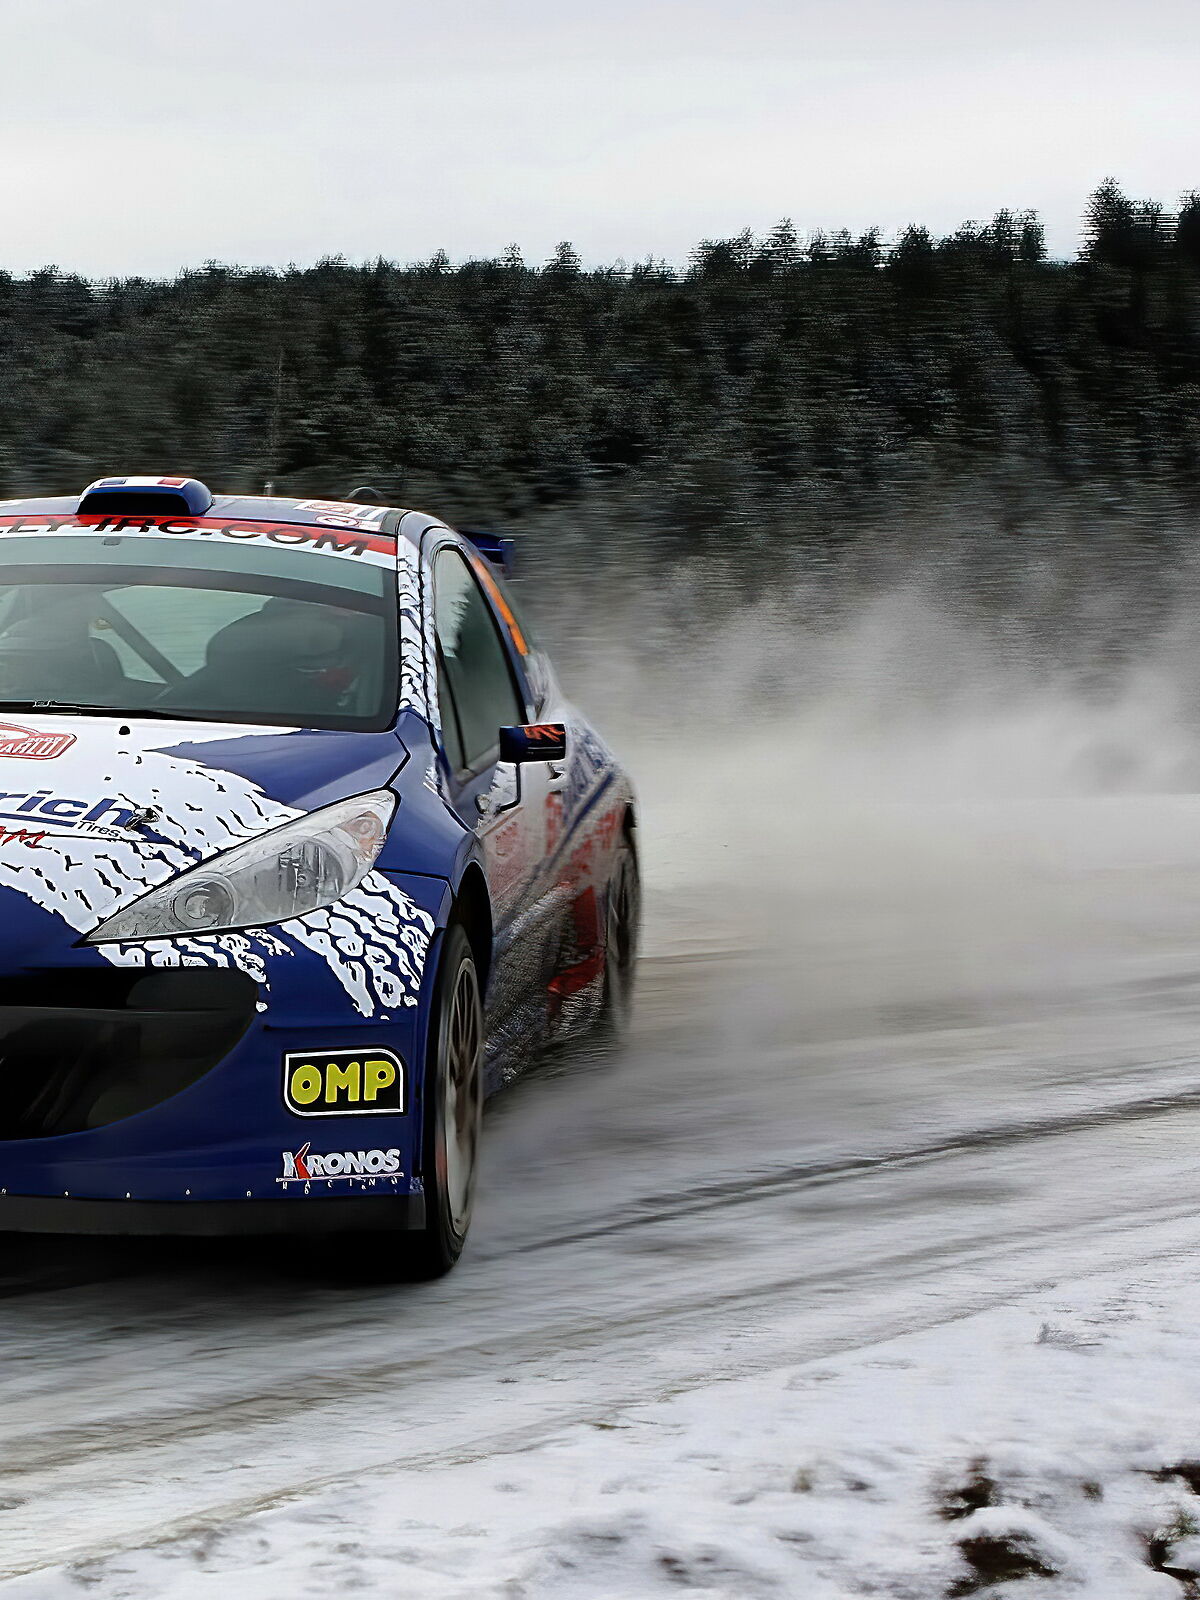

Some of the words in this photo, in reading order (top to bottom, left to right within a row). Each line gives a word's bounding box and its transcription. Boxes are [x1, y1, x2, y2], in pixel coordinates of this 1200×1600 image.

[76, 821, 121, 838] Tires
[290, 1060, 396, 1105] OMP
[282, 1142, 401, 1178] KRONOS
